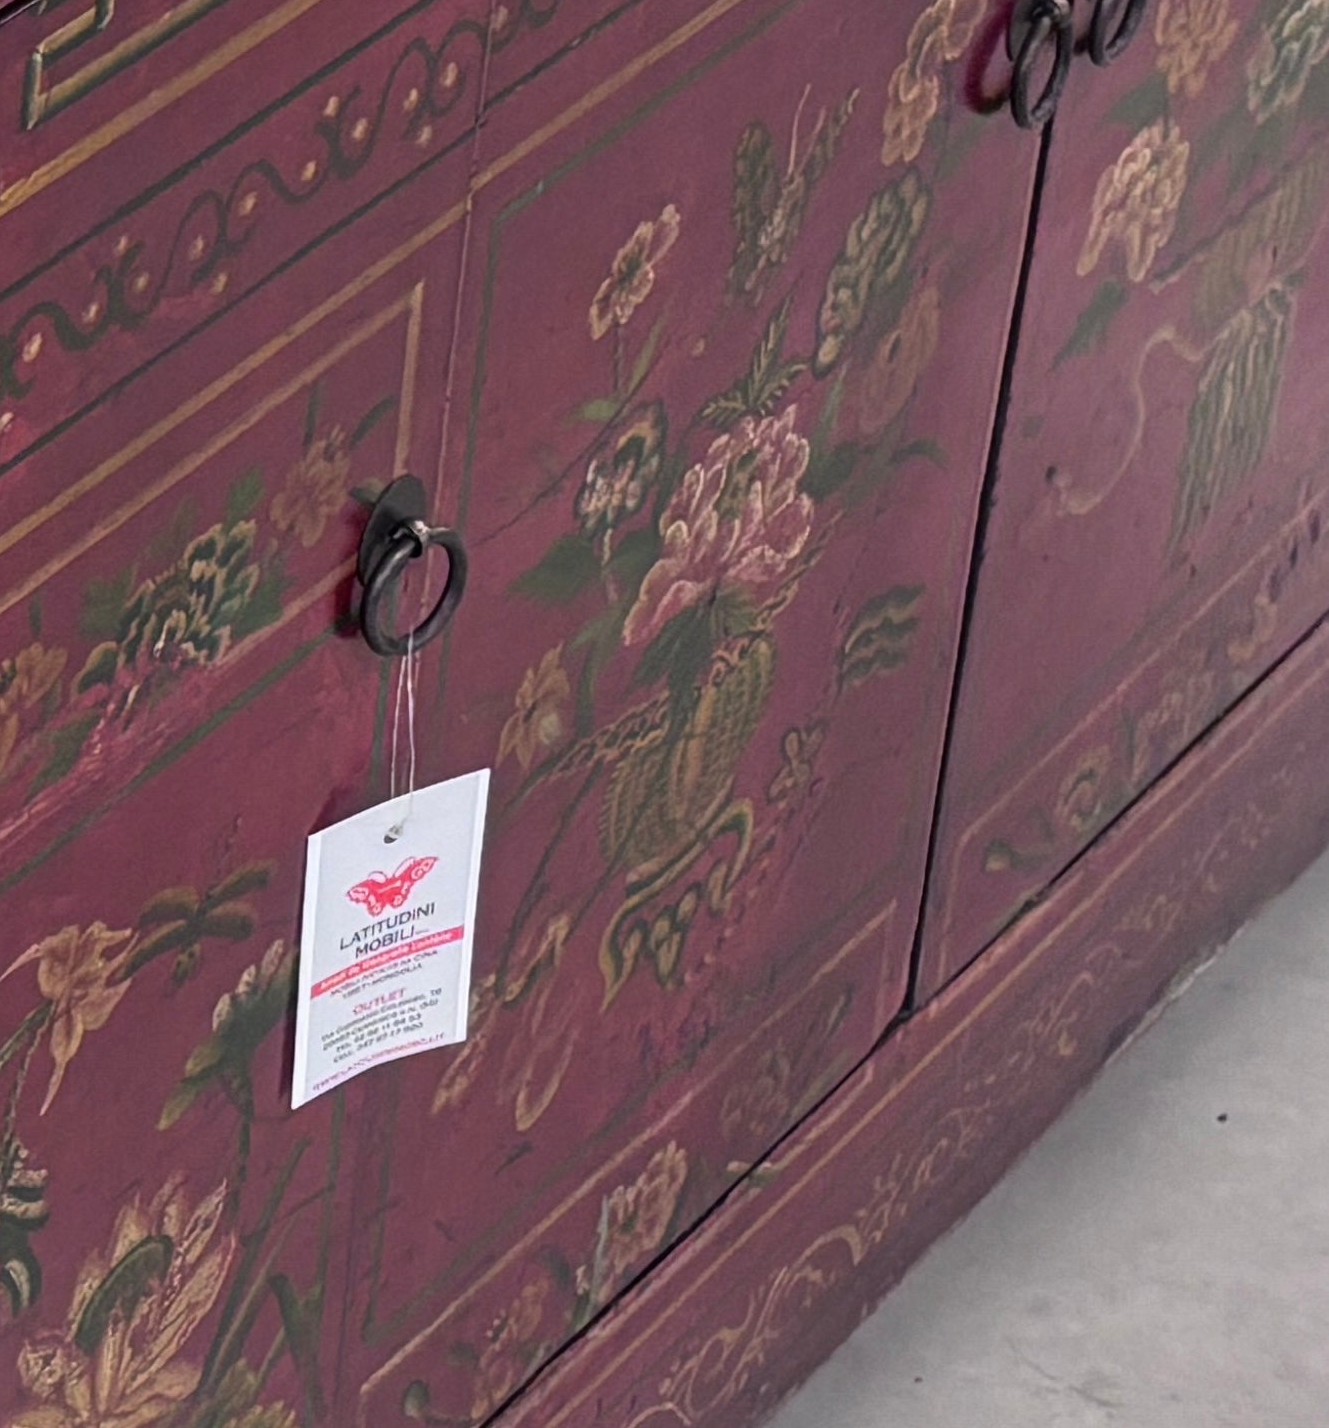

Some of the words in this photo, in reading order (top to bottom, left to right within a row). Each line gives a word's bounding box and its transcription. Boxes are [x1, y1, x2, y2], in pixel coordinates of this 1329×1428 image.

[340, 902, 435, 951] LATITUDINI
[355, 925, 415, 958] MOBILI
[352, 987, 406, 1015] OUTLET
